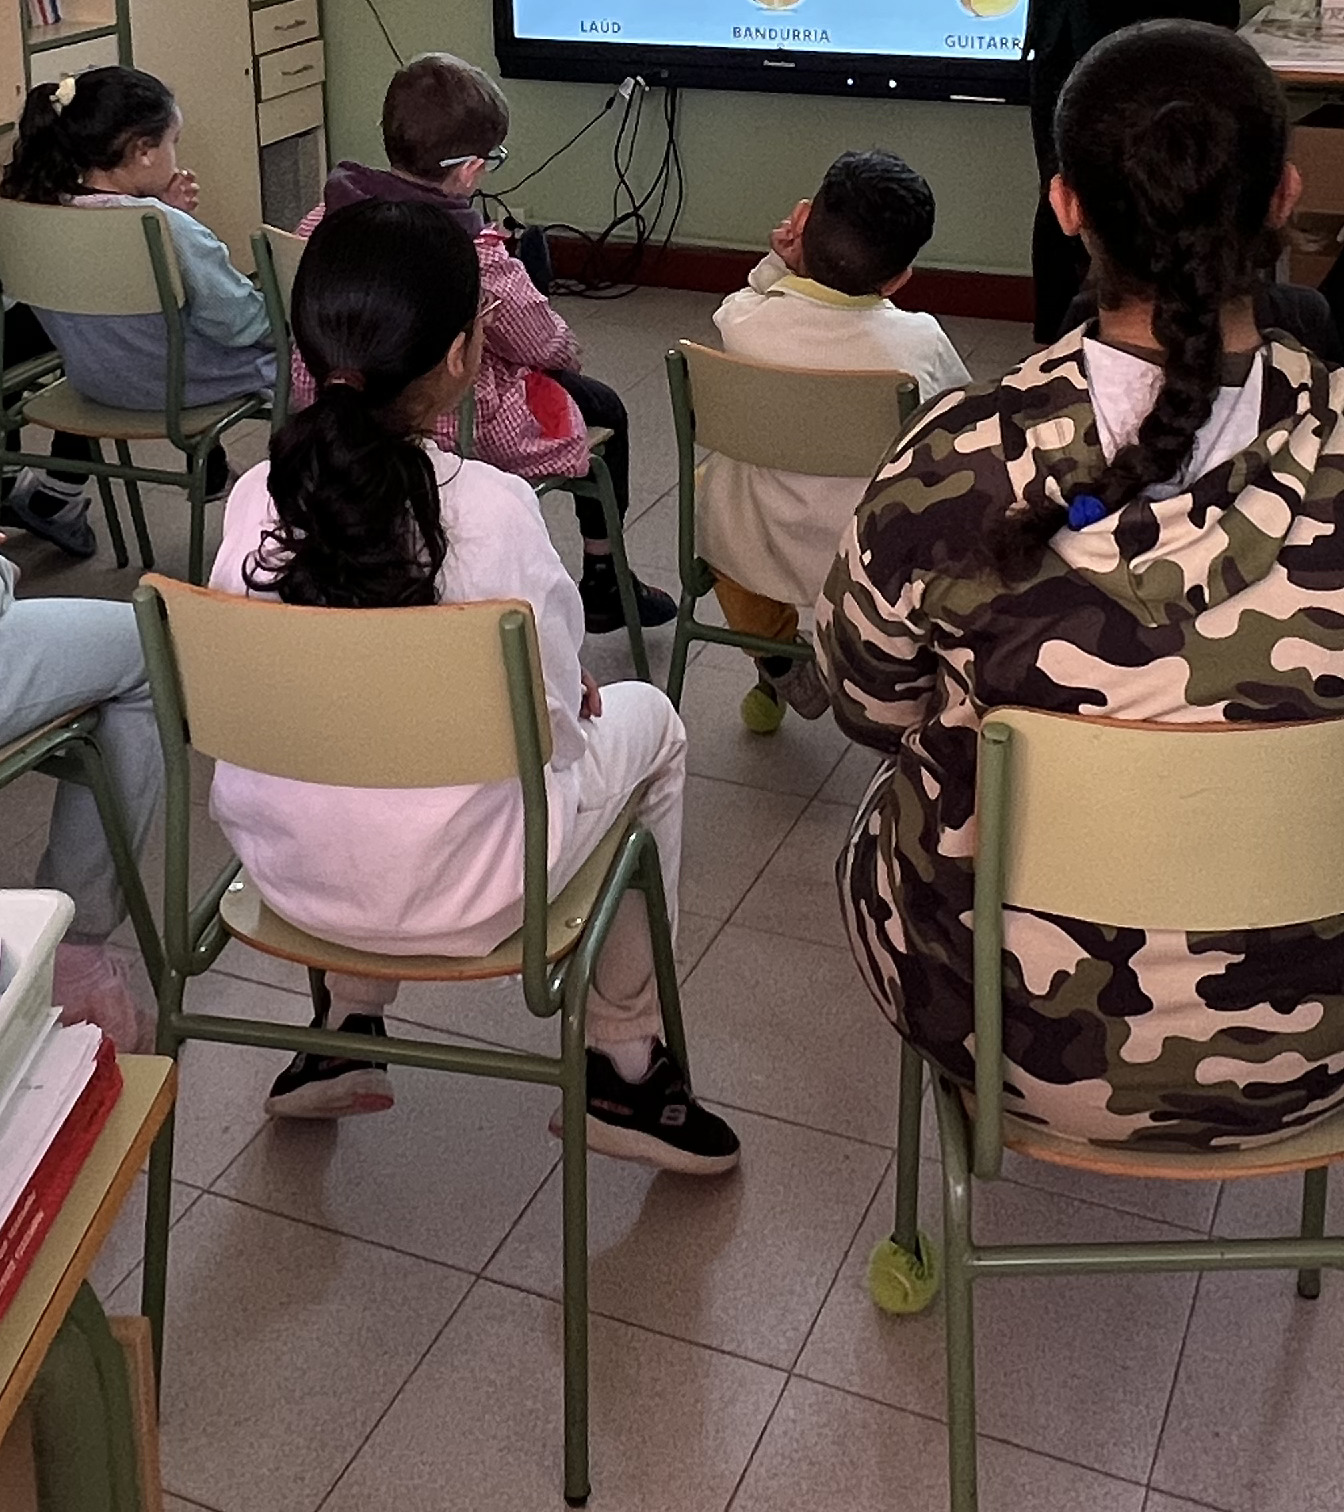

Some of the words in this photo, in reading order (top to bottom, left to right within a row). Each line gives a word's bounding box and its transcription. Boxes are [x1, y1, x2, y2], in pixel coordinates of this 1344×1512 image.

[580, 17, 622, 35] LAÚD
[732, 25, 831, 44] BANDURRIA
[944, 33, 1023, 51] GUITARR
